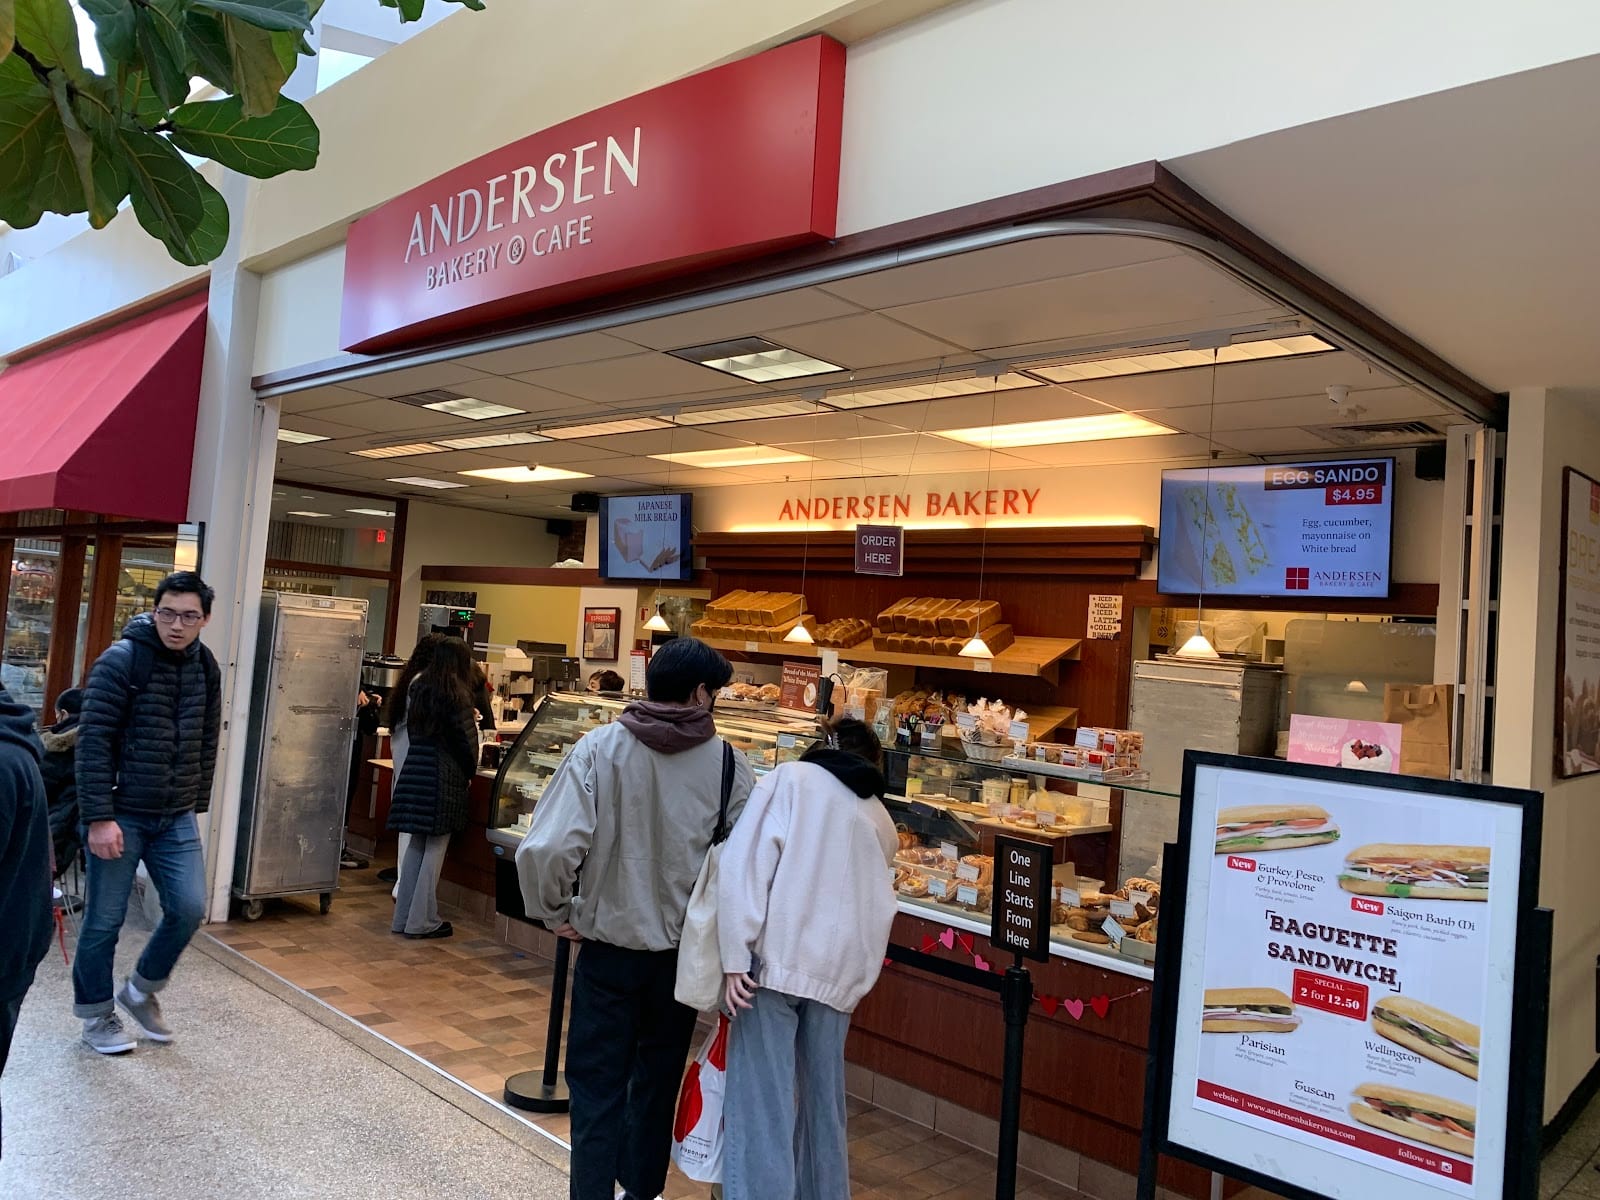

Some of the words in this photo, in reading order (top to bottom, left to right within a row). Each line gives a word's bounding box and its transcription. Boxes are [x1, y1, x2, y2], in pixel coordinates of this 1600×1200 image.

[404, 126, 641, 264] ANDERSEN
[426, 242, 502, 291] BAKERY
[532, 215, 593, 257] CAFE
[1272, 470, 1309, 485] EGG
[1314, 466, 1379, 483] SANDO
[778, 494, 911, 521] ANDERSEN
[926, 488, 1041, 517] BAKERY
[1332, 488, 1375, 503] $4.95
[638, 500, 673, 511] JAPANESE
[634, 512, 652, 522] MILK
[653, 512, 678, 522] BREAD
[1302, 518, 1321, 529] Egg,
[1323, 517, 1372, 528] cucumber,
[861, 534, 896, 548] ORDER
[1301, 531, 1357, 541] mayonnaise
[1358, 532, 1371, 540] on
[1301, 544, 1330, 553] White
[1330, 544, 1357, 553] bread
[864, 553, 892, 564] HERE
[1314, 571, 1382, 581] ANDERSEN
[1010, 850, 1031, 867] One
[1231, 858, 1253, 870] New
[1009, 869, 1031, 888] Line
[1266, 875, 1316, 892] Provolone
[1294, 869, 1326, 884] Pesto,
[1005, 889, 1034, 909] Starts
[1355, 900, 1380, 912] New
[1006, 909, 1032, 929] From
[1386, 905, 1423, 921] Saigon
[1426, 913, 1456, 927] Banh
[1006, 929, 1030, 949] Here
[1269, 914, 1397, 957] BAGUETTE
[1267, 941, 1397, 985] SANDWICH
[1314, 978, 1345, 991] SPECIAL
[1300, 987, 1308, 997] 2
[1311, 990, 1326, 1001] for
[1328, 994, 1360, 1010] 12.50
[1241, 1034, 1286, 1056] Parisian
[1364, 1040, 1422, 1064] Wellington
[1294, 1079, 1335, 1101] Tuscan
[1212, 1089, 1239, 1104] website
[1247, 1100, 1356, 1142] www.andersenbakeryusa.com
[1398, 1148, 1425, 1163] follow
[1425, 1159, 1437, 1167] us
